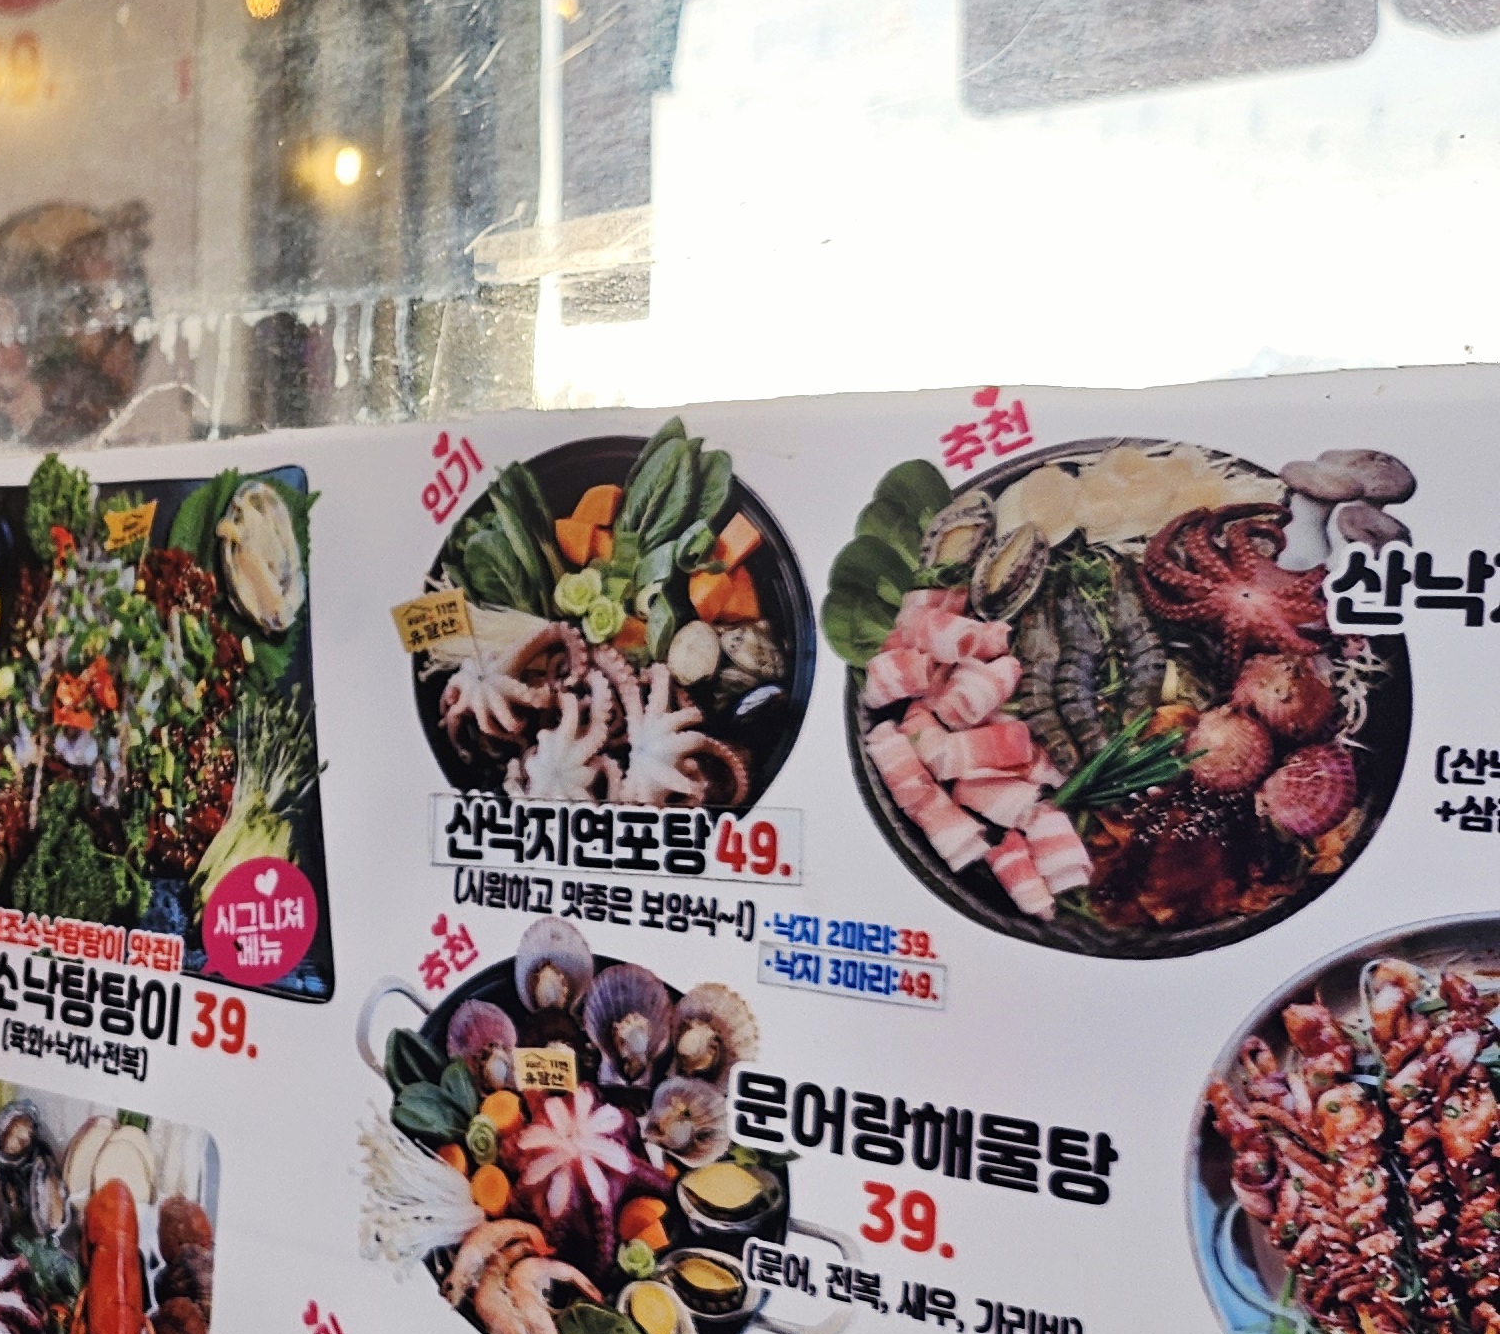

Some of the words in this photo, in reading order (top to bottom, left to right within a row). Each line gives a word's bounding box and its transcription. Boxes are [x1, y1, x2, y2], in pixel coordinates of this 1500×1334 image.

[940, 400, 1035, 471] 추천
[421, 436, 486, 524] 인기
[1331, 549, 1500, 629] 산낙
[445, 801, 712, 875] 산낙지연포탕
[714, 820, 791, 876] 49.
[1434, 795, 1500, 833] +삼
[213, 897, 305, 935] 시그니처
[454, 867, 554, 914] (시원하고
[561, 880, 633, 926] 맛좋은
[237, 934, 283, 966] 메뉴
[418, 924, 480, 991] 추천
[190, 990, 258, 1059] 39.
[734, 1070, 1118, 1206] 문어랑해물탕
[859, 1180, 956, 1259] 39.
